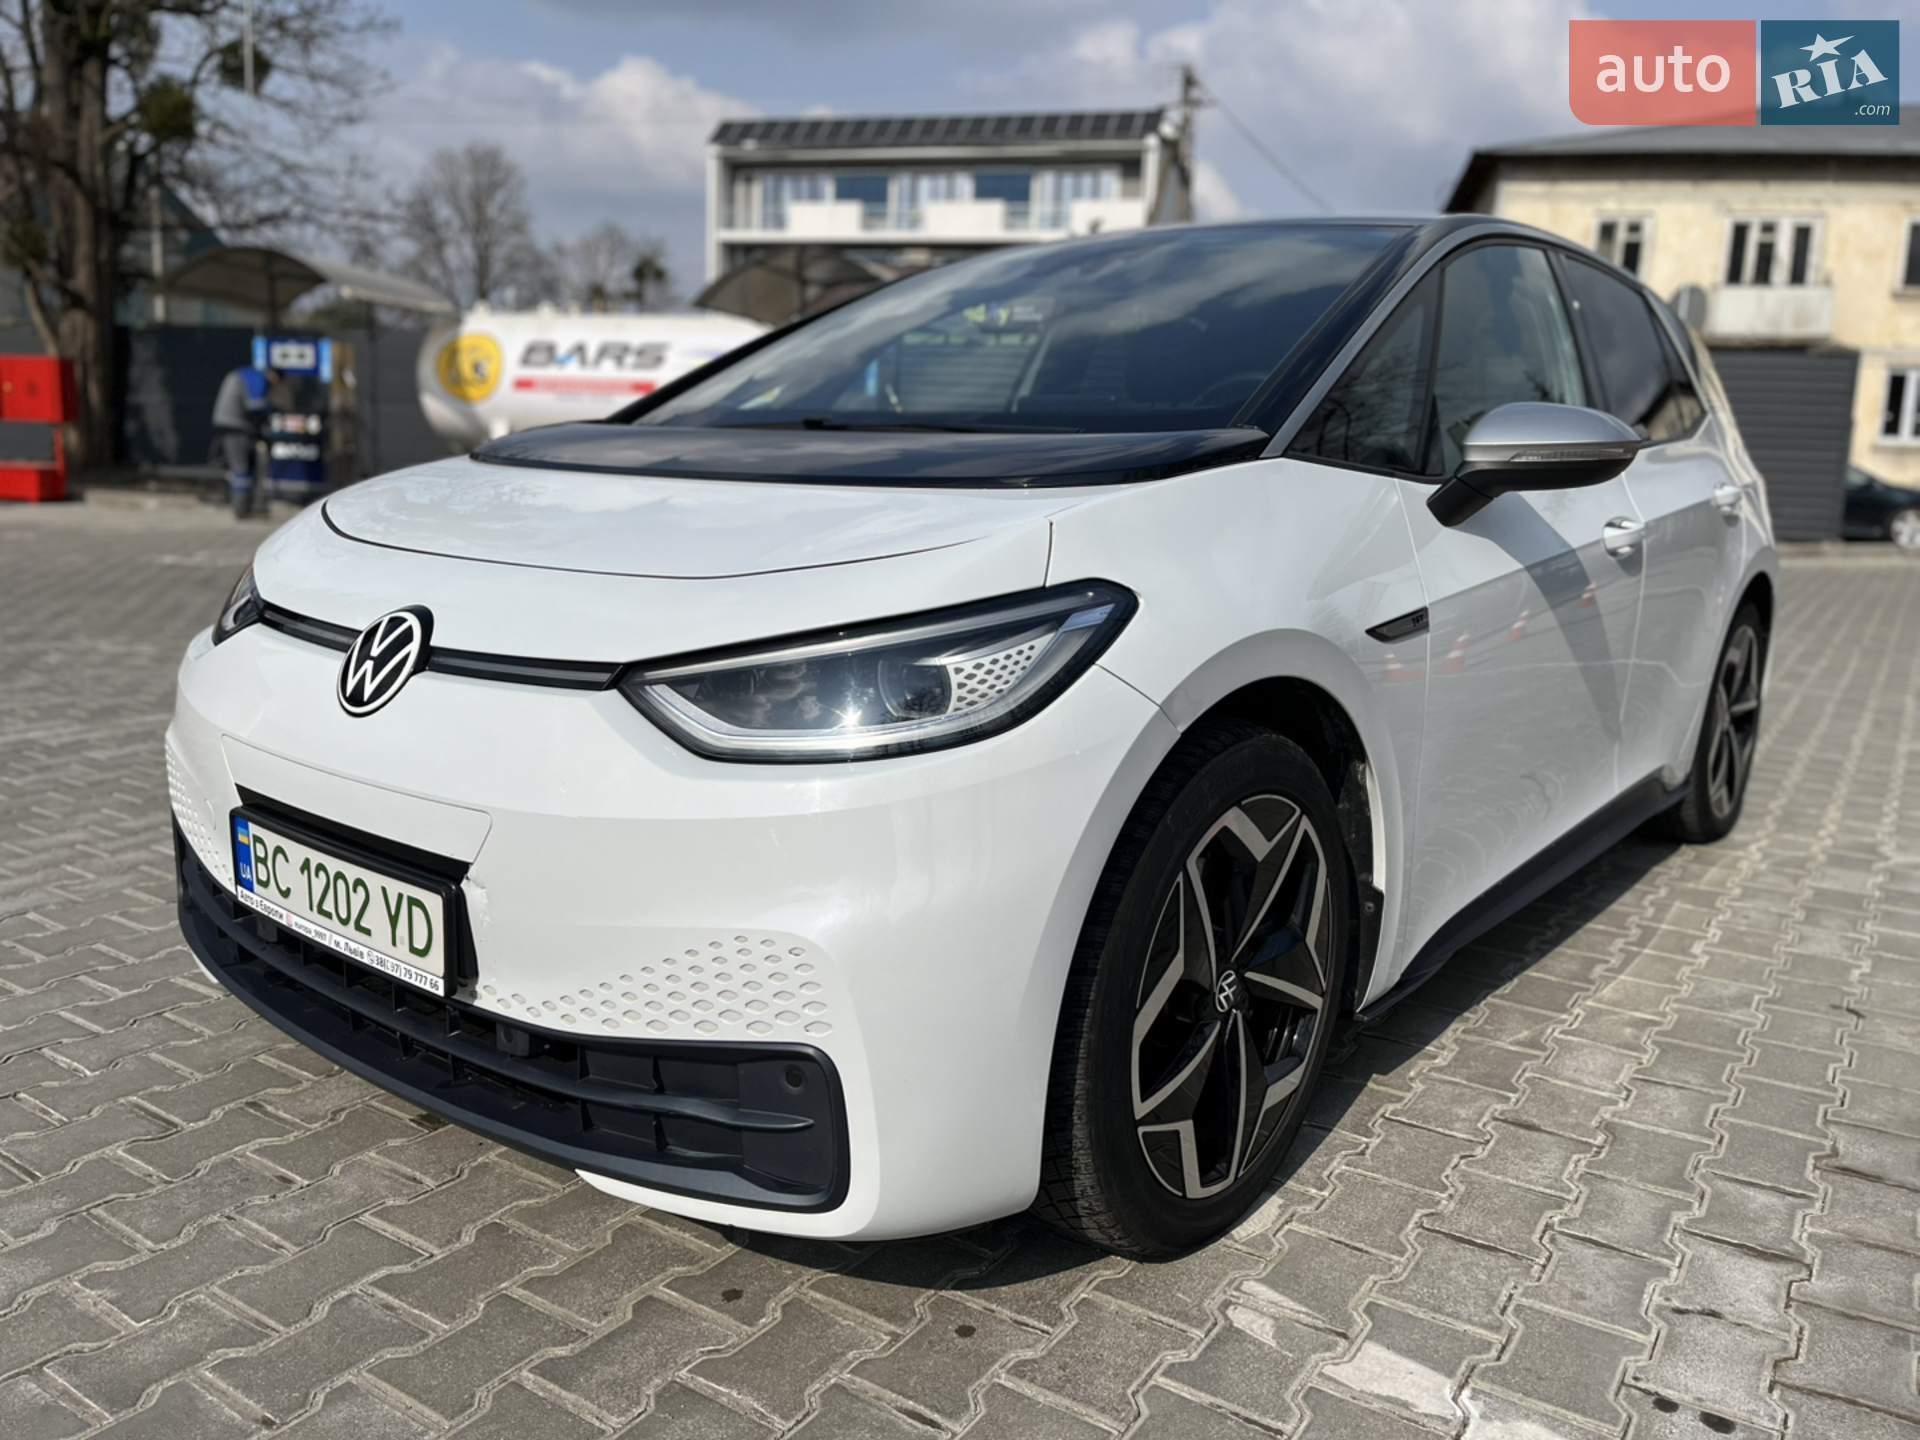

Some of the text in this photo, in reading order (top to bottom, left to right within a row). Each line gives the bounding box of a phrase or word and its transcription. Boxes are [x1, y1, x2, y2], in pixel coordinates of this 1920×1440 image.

[518, 341, 671, 369] BARS
[240, 862, 253, 882] UA
[252, 833, 433, 958] BC 1202 YD
